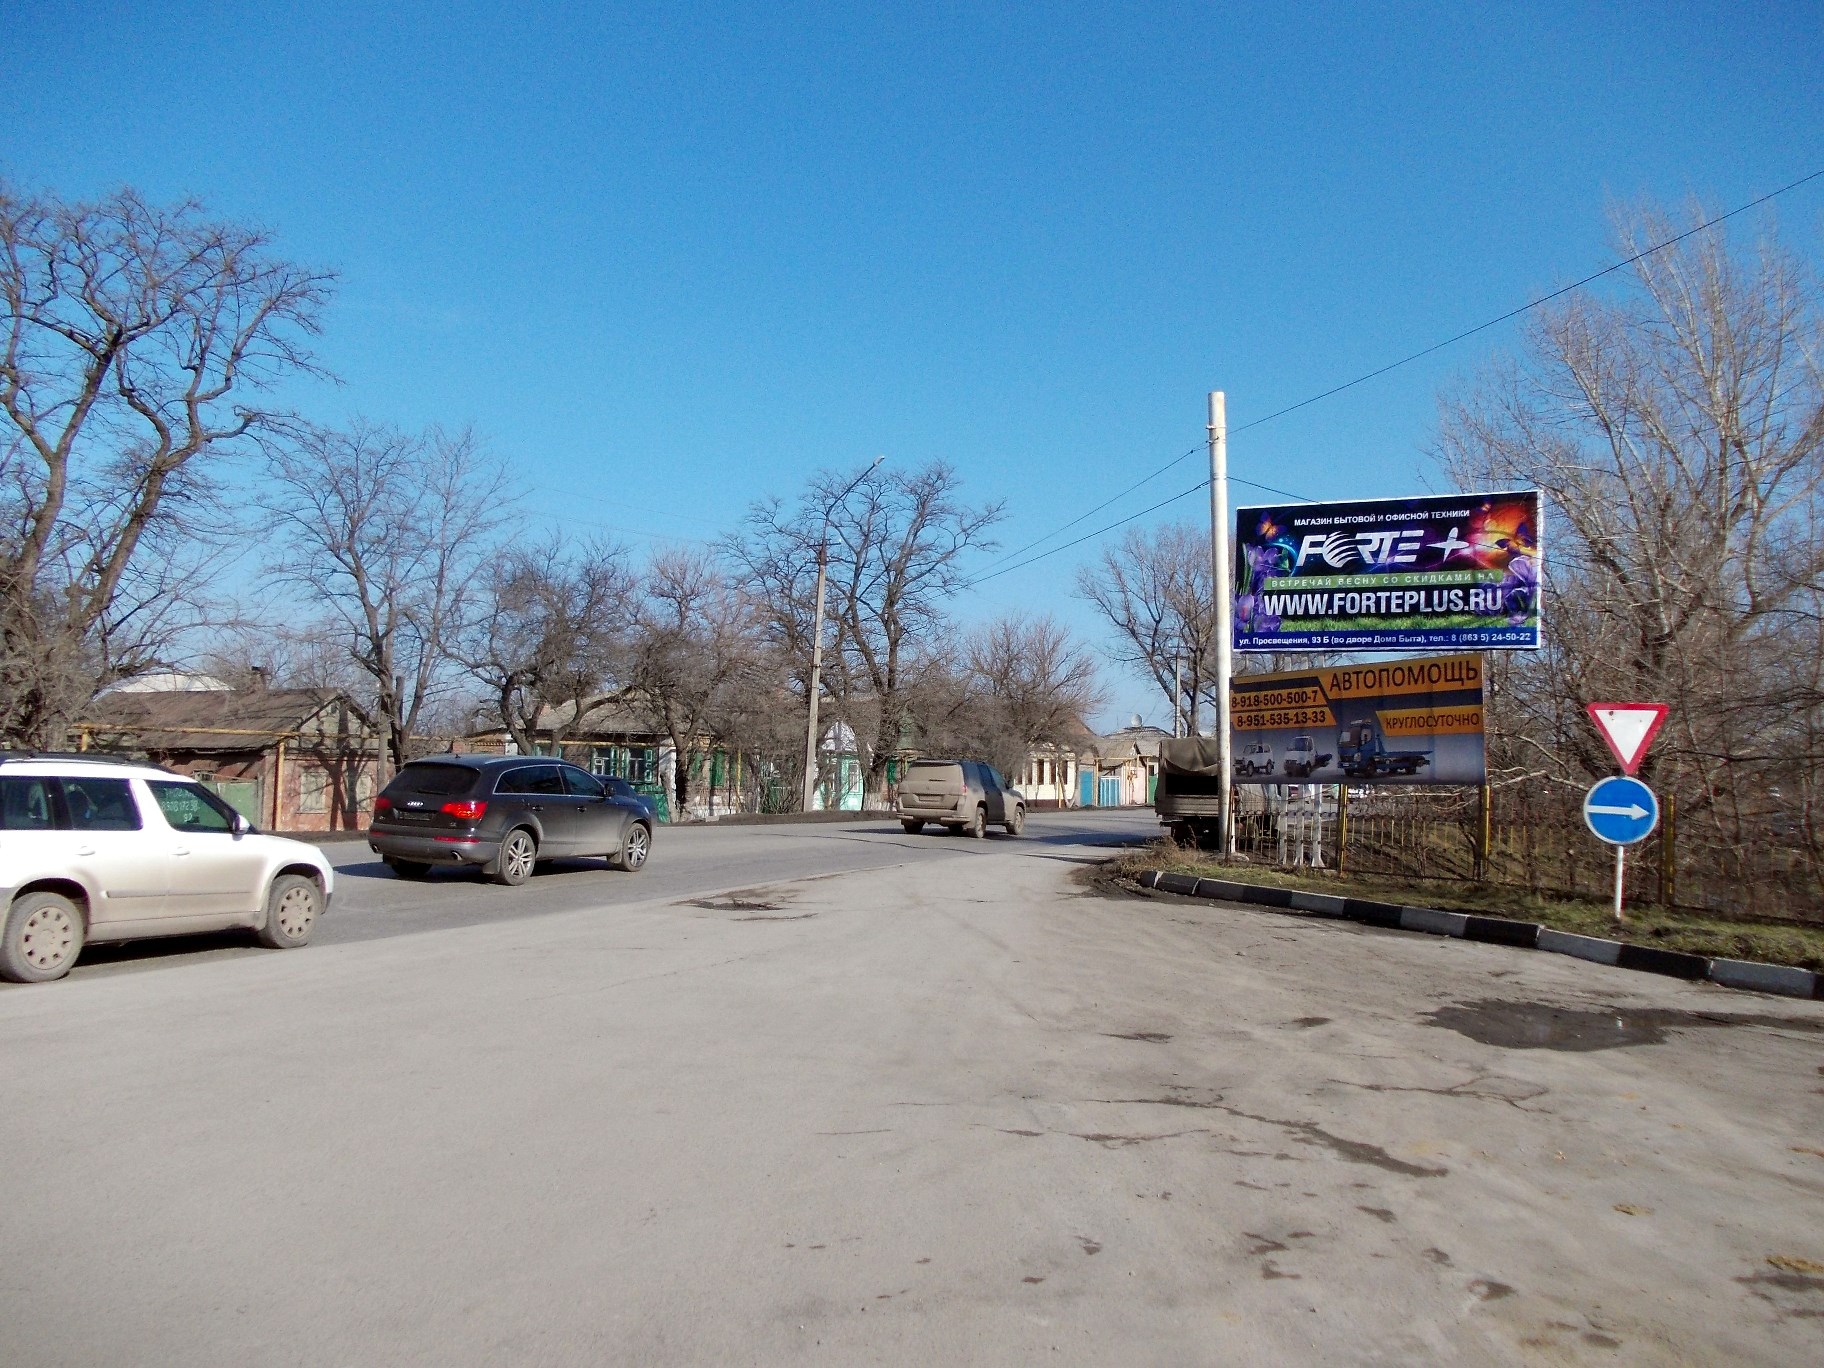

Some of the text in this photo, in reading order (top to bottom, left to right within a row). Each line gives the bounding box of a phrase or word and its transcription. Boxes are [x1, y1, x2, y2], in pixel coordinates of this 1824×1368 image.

[1294, 509, 1470, 527] МАГАЗИН БЫТОВОЙ И ОФИСНОЙ ТЕХНИКИ
[1295, 529, 1425, 568] FORTE
[1271, 572, 1495, 588] ВСТРЕЧАЙ ВЕСНУ СО СКИДКАМИ НА
[1263, 588, 1503, 616] WWW.FORTEPLUS.RU
[1239, 638, 1251, 646] ул.
[1252, 637, 1310, 646] Просвещения,
[1311, 636, 1322, 644] 93
[1323, 636, 1330, 644] Б
[1331, 636, 1344, 645] (во
[1346, 636, 1372, 645] дворе
[1374, 635, 1397, 644] Дома
[1398, 634, 1427, 644] Быта),
[1451, 634, 1457, 642] 8
[1459, 633, 1478, 643] (863
[1480, 633, 1490, 642] 5)
[1491, 632, 1531, 641] 24-50-22
[1330, 660, 1478, 692] АВТОПОМОЩЬ
[1231, 690, 1318, 708] 8-918-500-500-7
[1237, 710, 1325, 728] 8-951-535-13-33
[1386, 712, 1480, 729] КРУГЛОСУТОЧНО
